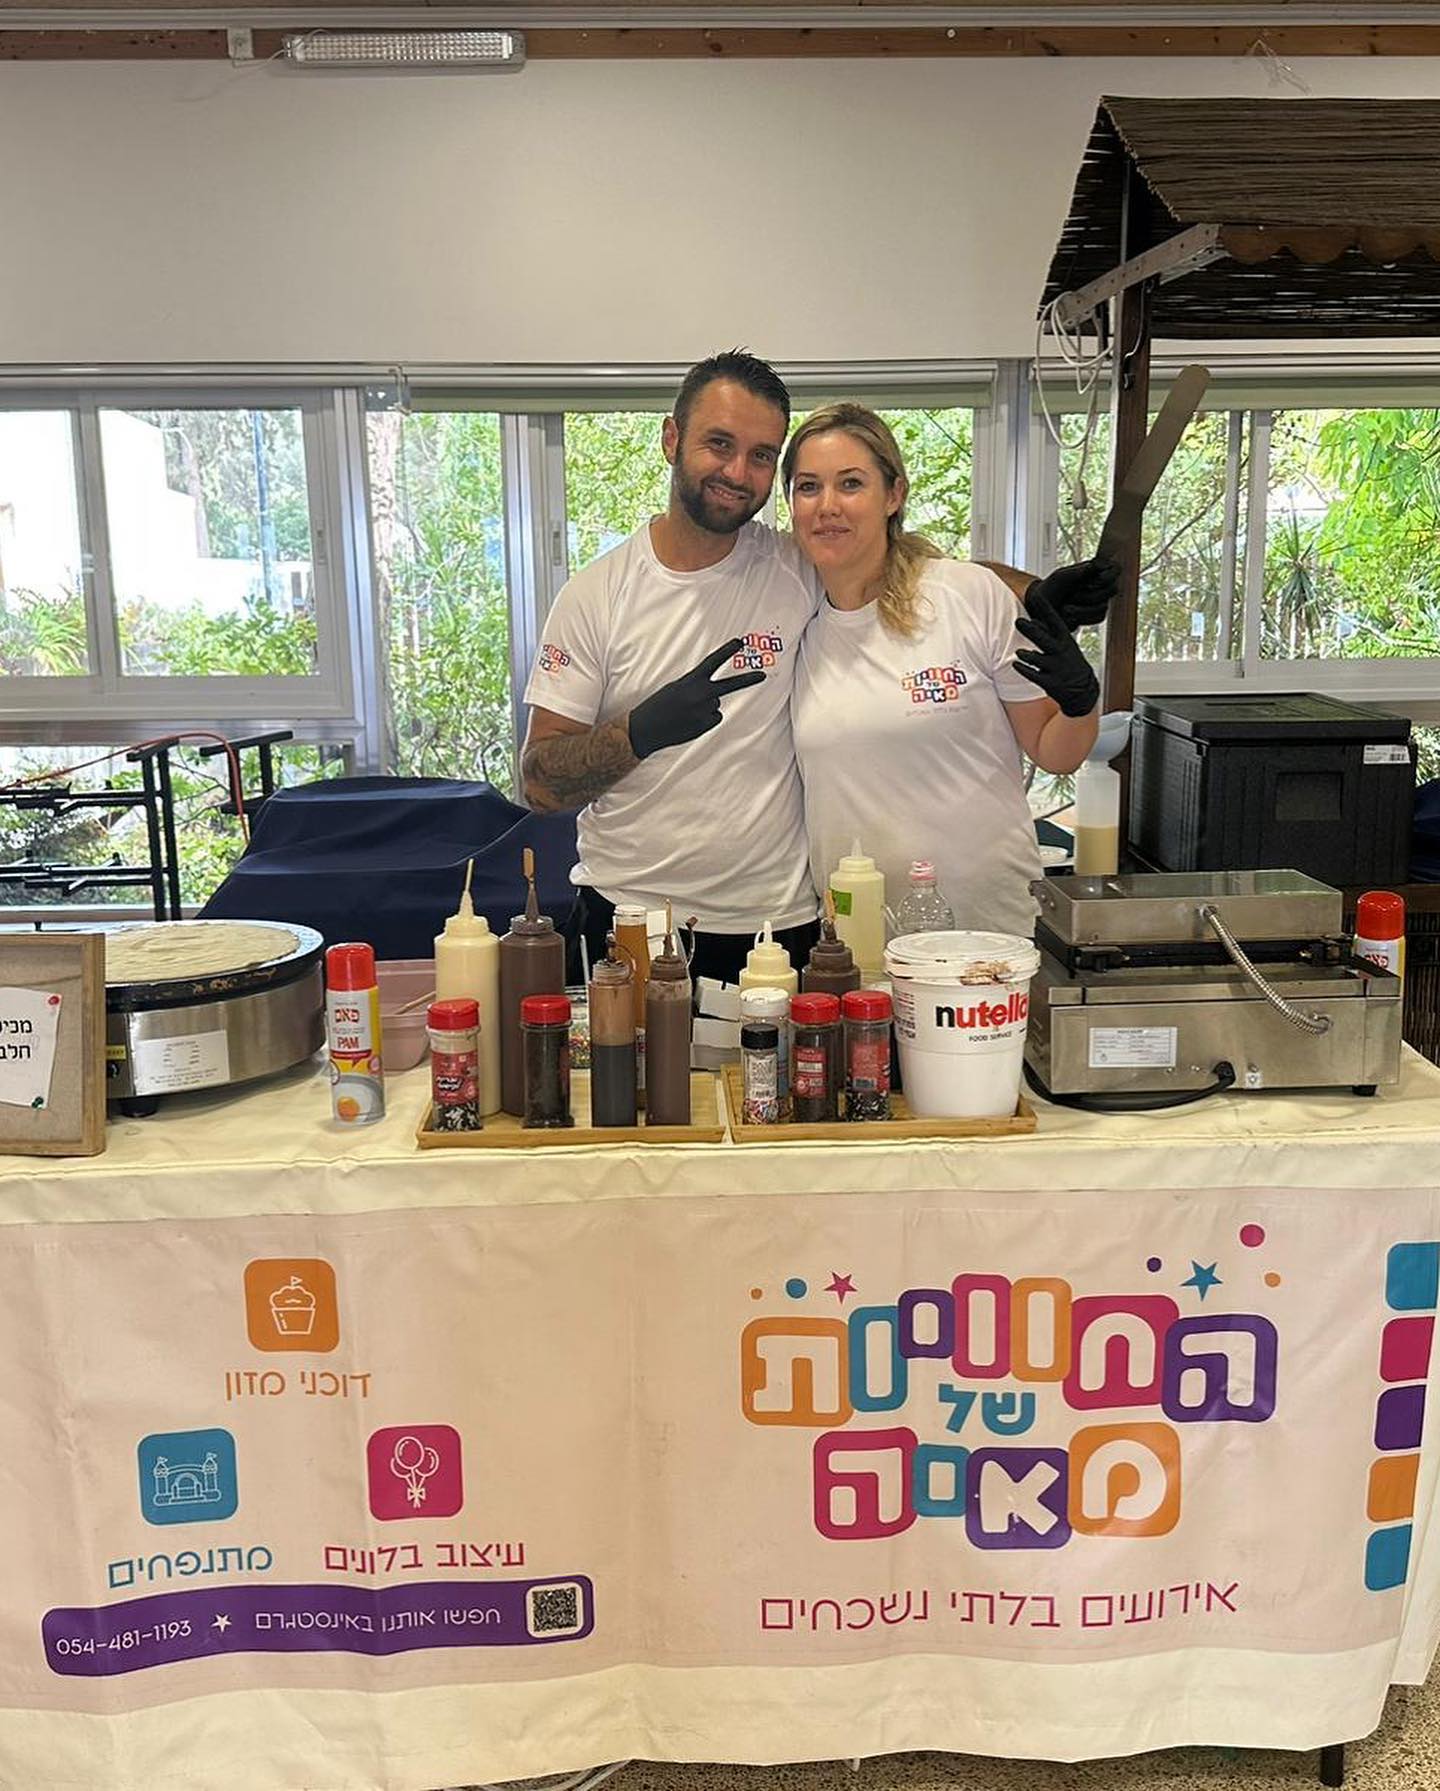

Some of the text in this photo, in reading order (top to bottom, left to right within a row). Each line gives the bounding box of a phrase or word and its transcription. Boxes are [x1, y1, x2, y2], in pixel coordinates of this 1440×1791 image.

[733, 651, 776, 669] מאיה
[901, 667, 967, 690] החוויות
[912, 685, 959, 703] מאיה
[334, 1008, 359, 1022] פאם
[935, 992, 1028, 1029] nutella
[0, 1020, 32, 1034] מכי
[968, 1030, 1012, 1042] FOOD SERVICE
[337, 1036, 359, 1049] PAM
[743, 1275, 1276, 1425] החוויות
[225, 1371, 371, 1401] דוכני מזון
[938, 1383, 1036, 1436] של
[816, 1423, 1179, 1549] מאיה
[108, 1546, 273, 1588] מתנפחים
[324, 1542, 525, 1575] עיצוב בלונים
[255, 1608, 501, 1633] חפשו אותנו באינסטגרם
[761, 1582, 1239, 1631] אירועים בלתי נשכחים
[56, 1620, 193, 1655] 054-481-1193
